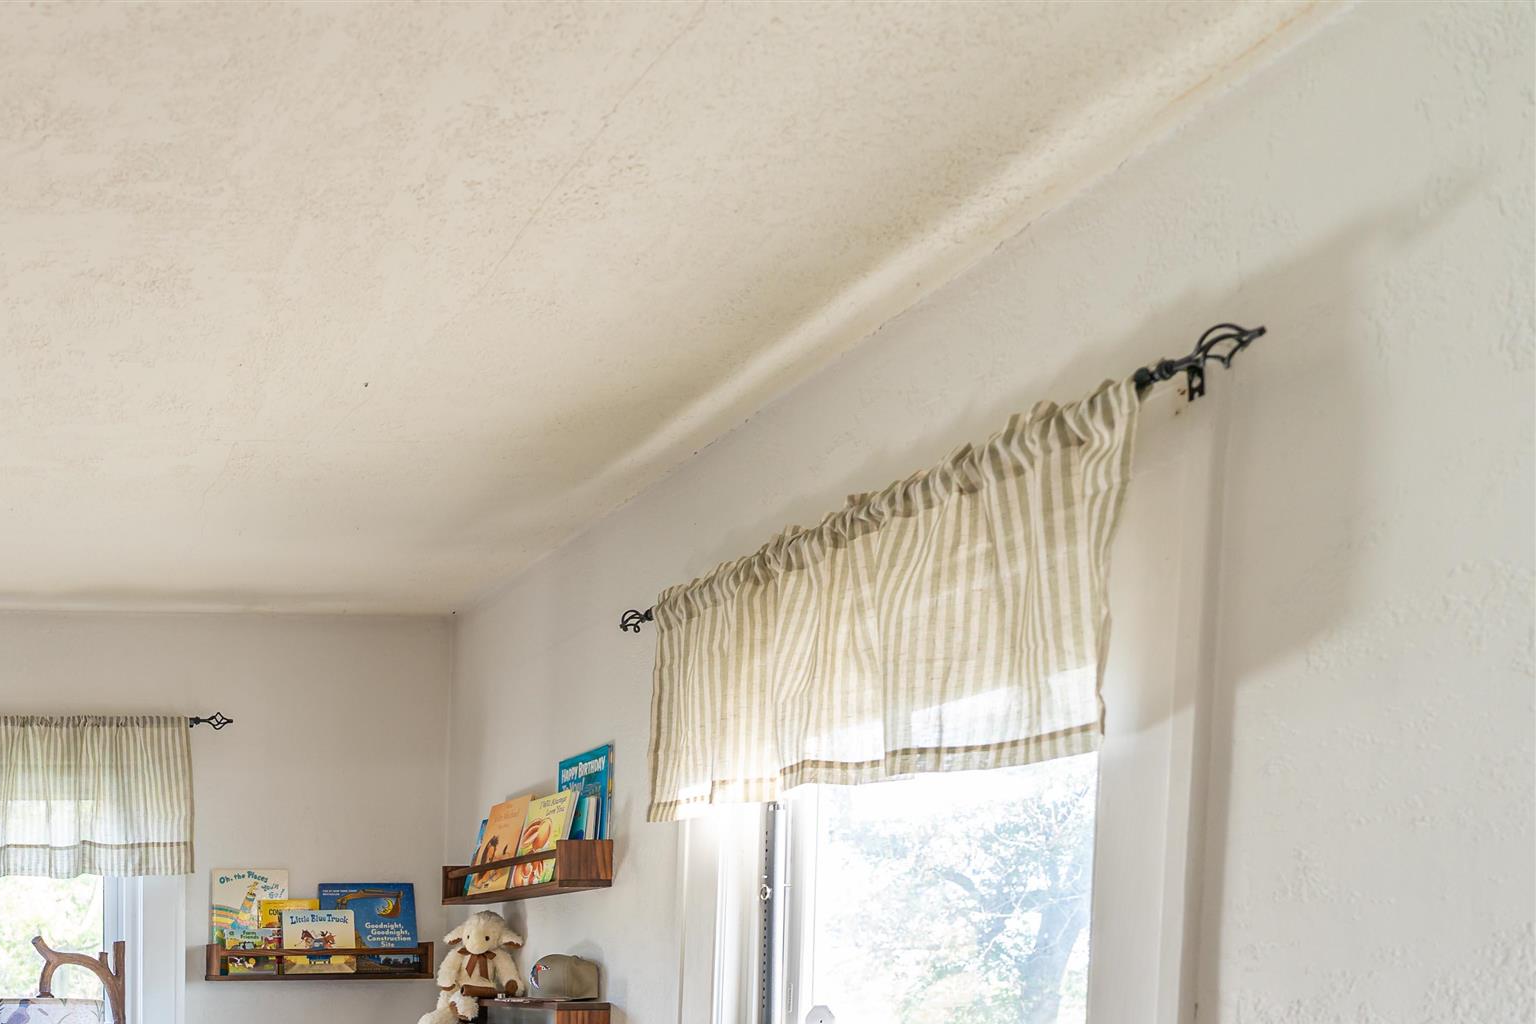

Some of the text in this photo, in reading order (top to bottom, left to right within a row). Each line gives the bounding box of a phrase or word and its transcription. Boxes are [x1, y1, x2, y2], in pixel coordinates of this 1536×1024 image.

[290, 913, 349, 925] Little Blue Truck
